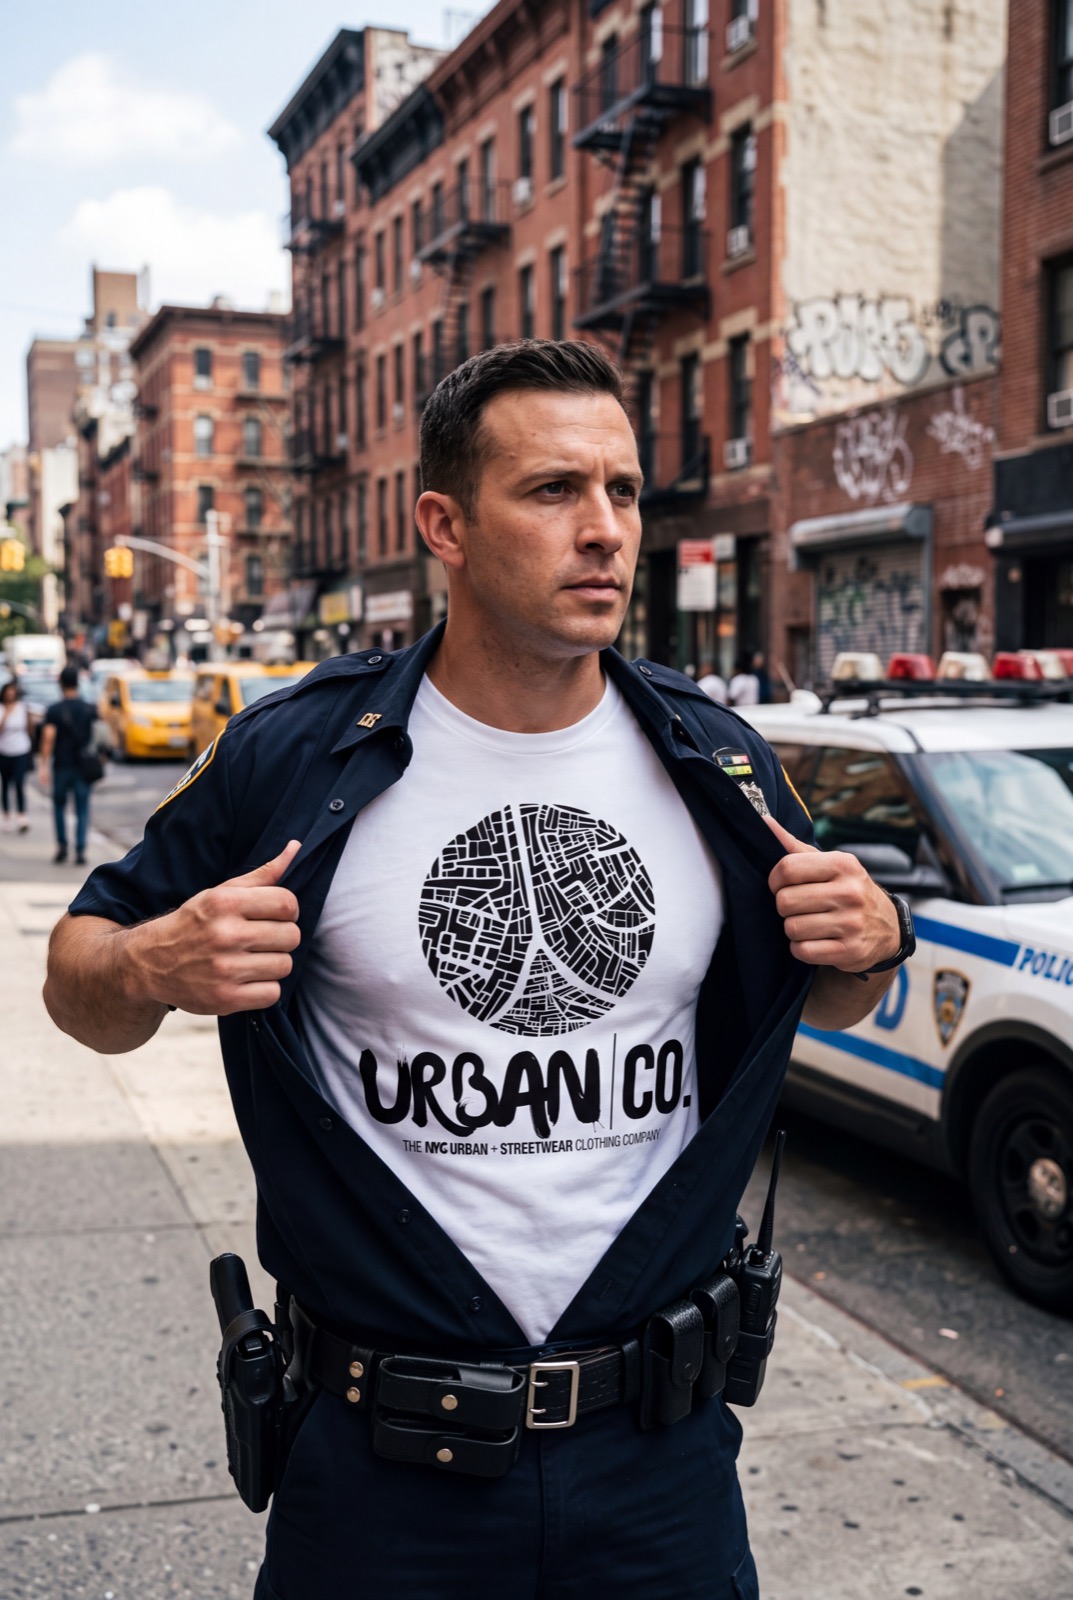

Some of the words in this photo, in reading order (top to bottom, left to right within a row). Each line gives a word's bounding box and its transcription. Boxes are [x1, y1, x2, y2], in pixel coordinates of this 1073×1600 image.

[359, 1044, 601, 1139] URBAN
[622, 1039, 691, 1120] CO.
[402, 1139, 422, 1153] THE
[425, 1141, 448, 1154] NYC
[450, 1143, 488, 1155] URBAN
[500, 1140, 573, 1155] STREETWEAR
[575, 1137, 621, 1151] CLOTHING
[622, 1128, 661, 1146] COMPANY
